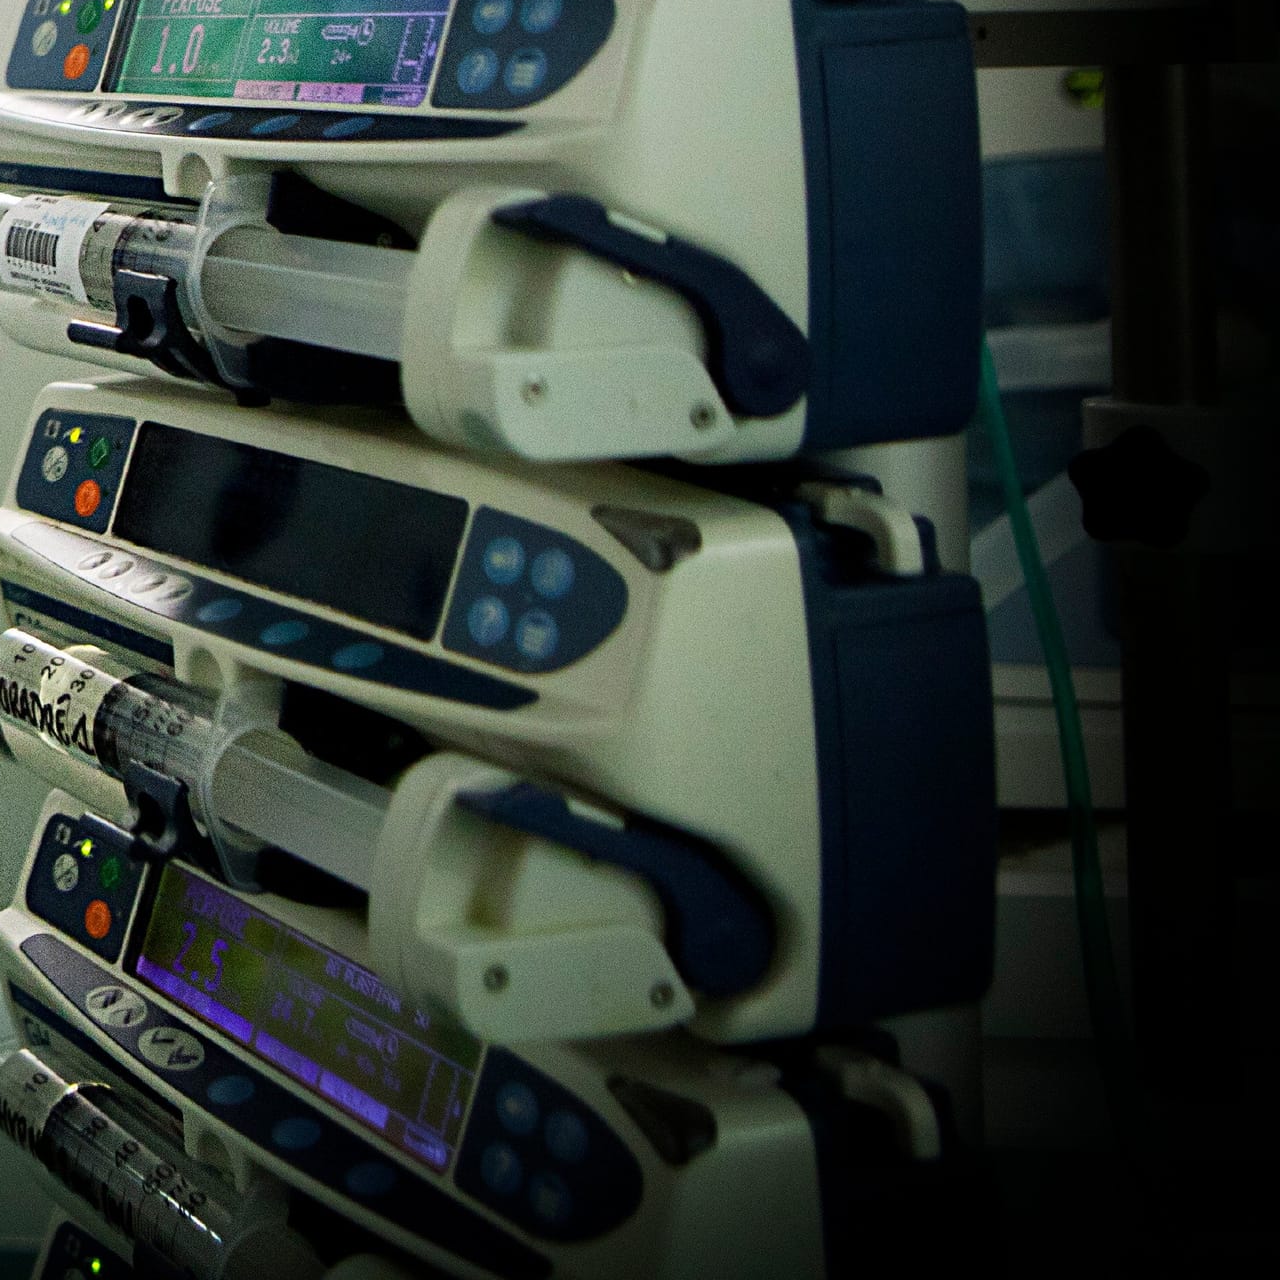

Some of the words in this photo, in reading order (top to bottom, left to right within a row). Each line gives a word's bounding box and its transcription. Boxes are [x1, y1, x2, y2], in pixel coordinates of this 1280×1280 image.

[151, 24, 205, 74] 1.0
[14, 643, 36, 664] 10
[40, 656, 65, 680] 20
[70, 669, 95, 693] 30
[172, 920, 229, 992] 2.5
[24, 1072, 49, 1095] 10
[115, 1140, 140, 1167] 40
